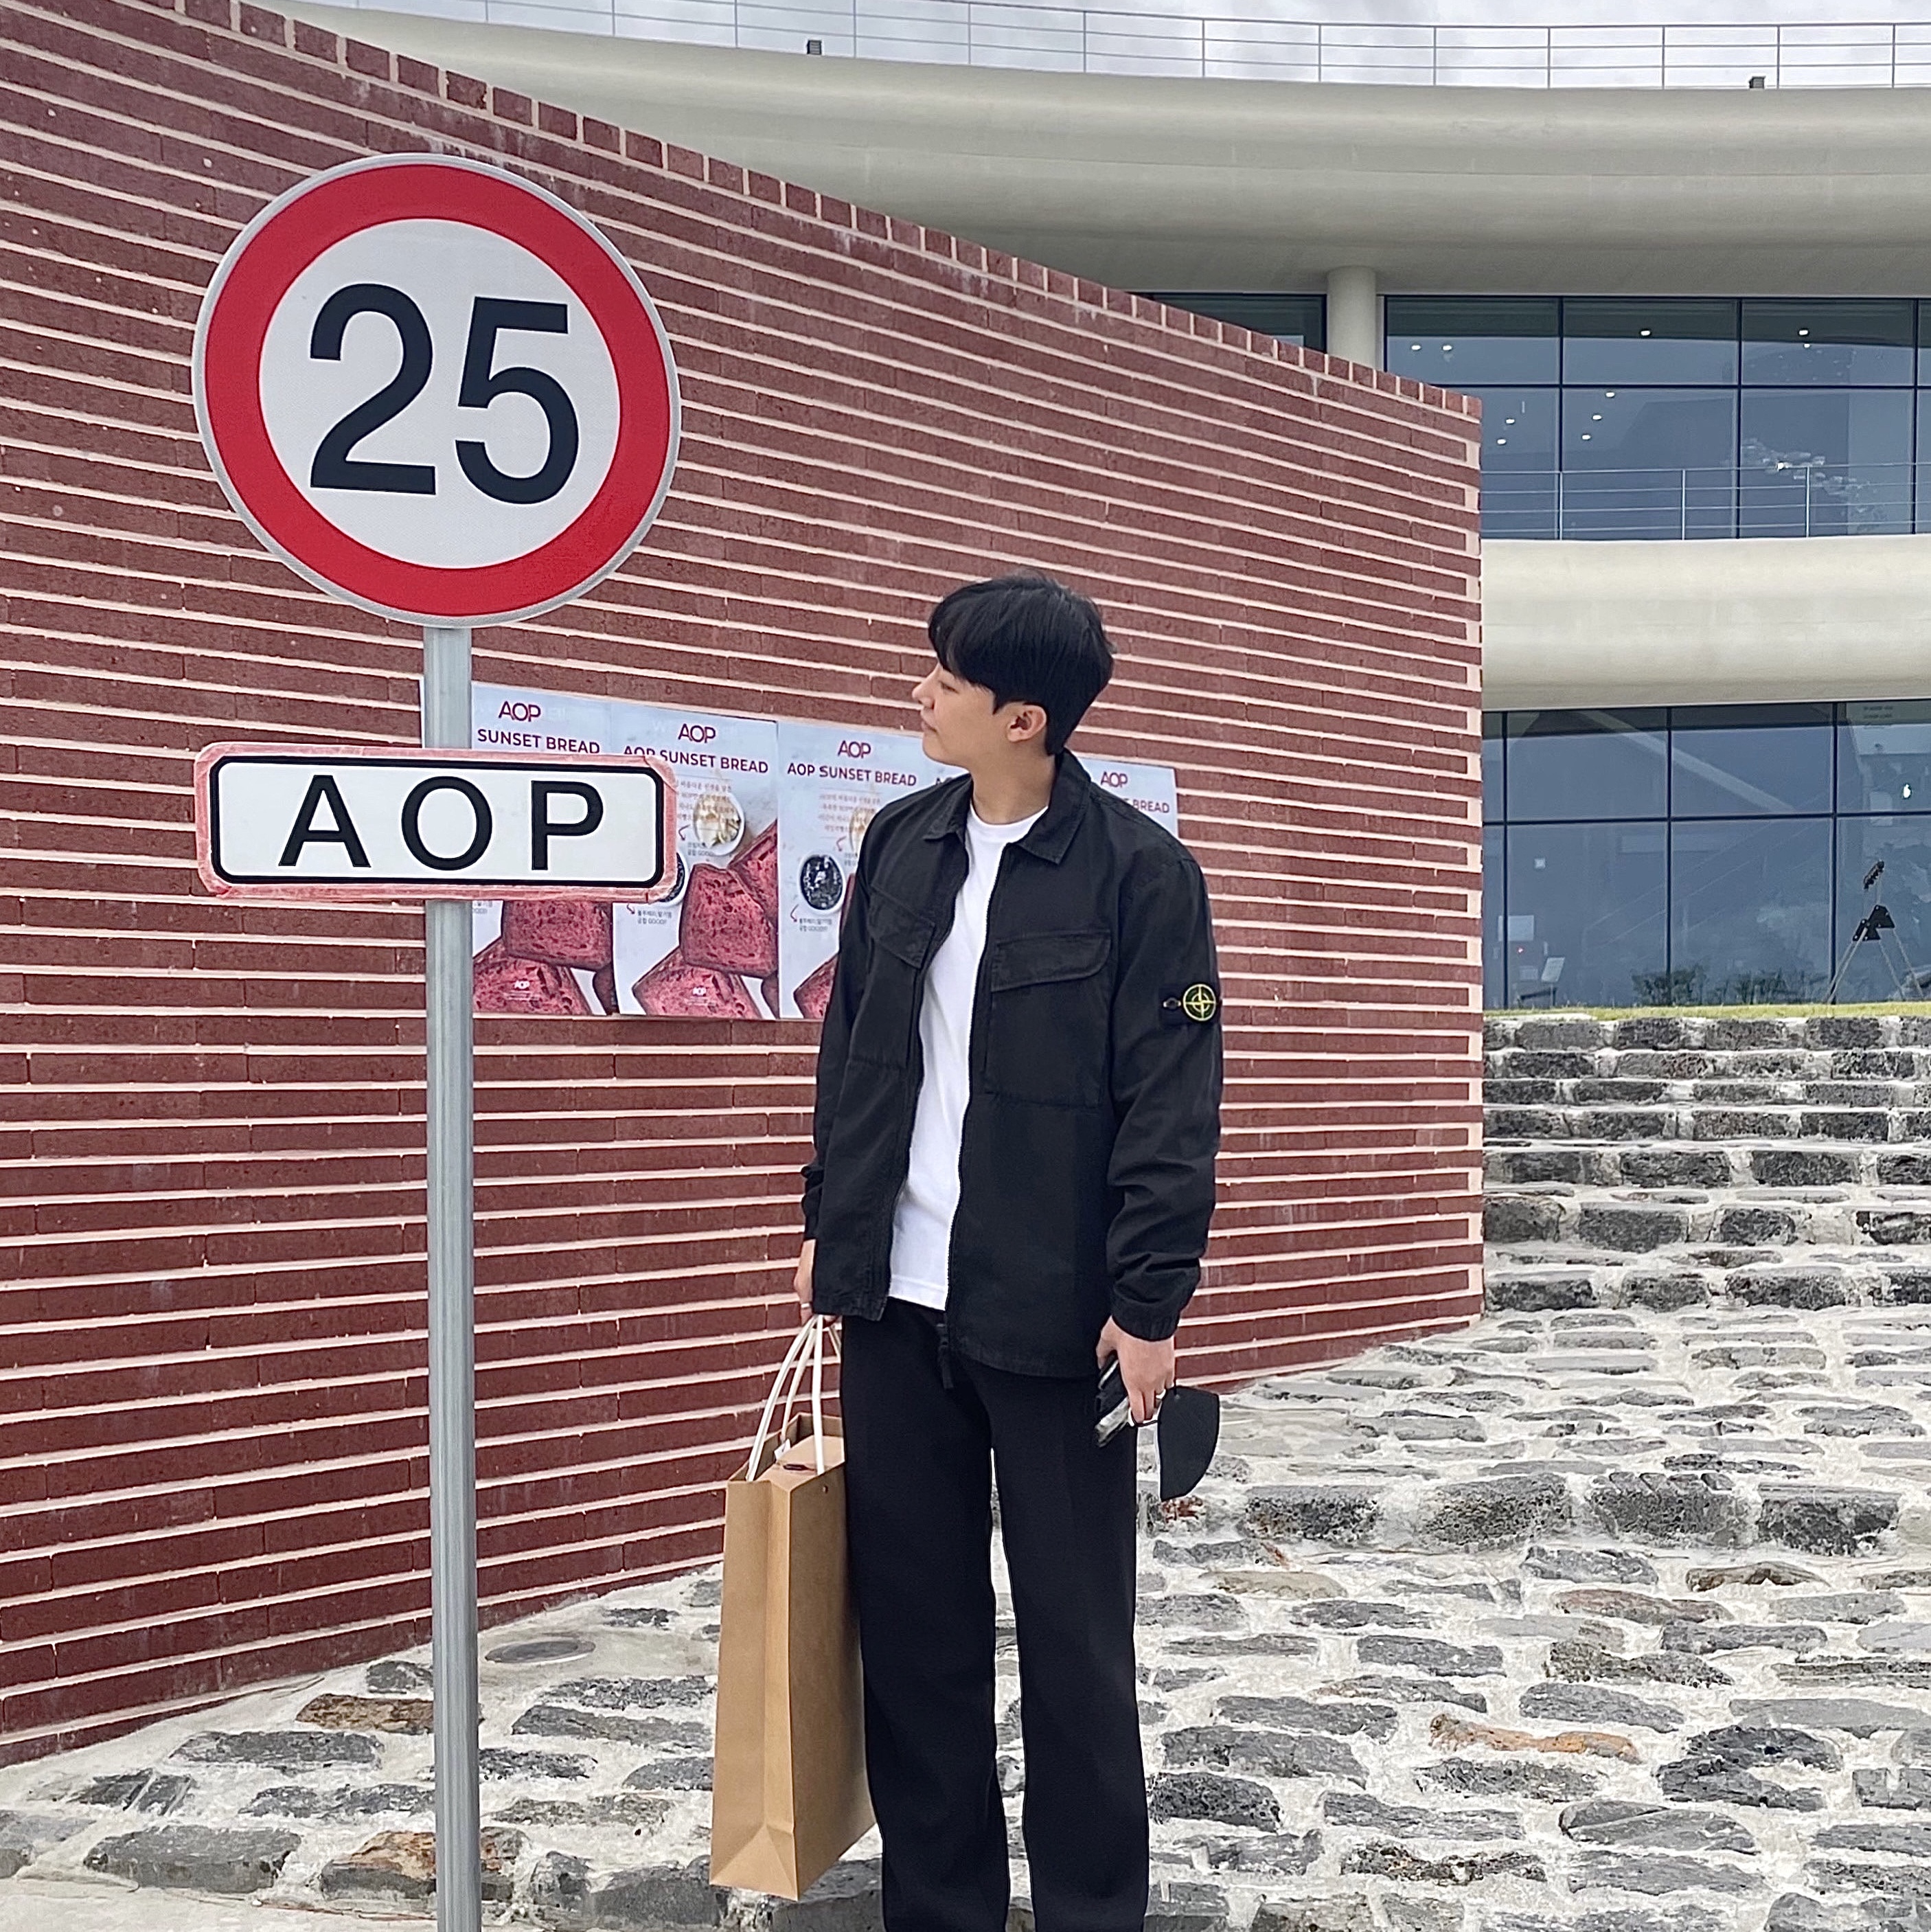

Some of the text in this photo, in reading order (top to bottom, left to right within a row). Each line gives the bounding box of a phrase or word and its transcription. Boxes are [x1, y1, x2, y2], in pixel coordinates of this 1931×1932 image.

[310, 283, 579, 505] 25
[498, 701, 541, 722] AOP
[477, 729, 600, 753] SUNSET BREAD
[678, 723, 716, 743] AOP
[838, 740, 871, 758] AOP
[660, 749, 716, 768] SUNSET
[721, 757, 768, 773] BREAD
[788, 762, 917, 786] AOP SUNSET BREAD
[1101, 771, 1128, 788] AOP
[1133, 799, 1170, 813] BREAD
[279, 774, 604, 870] AOP
